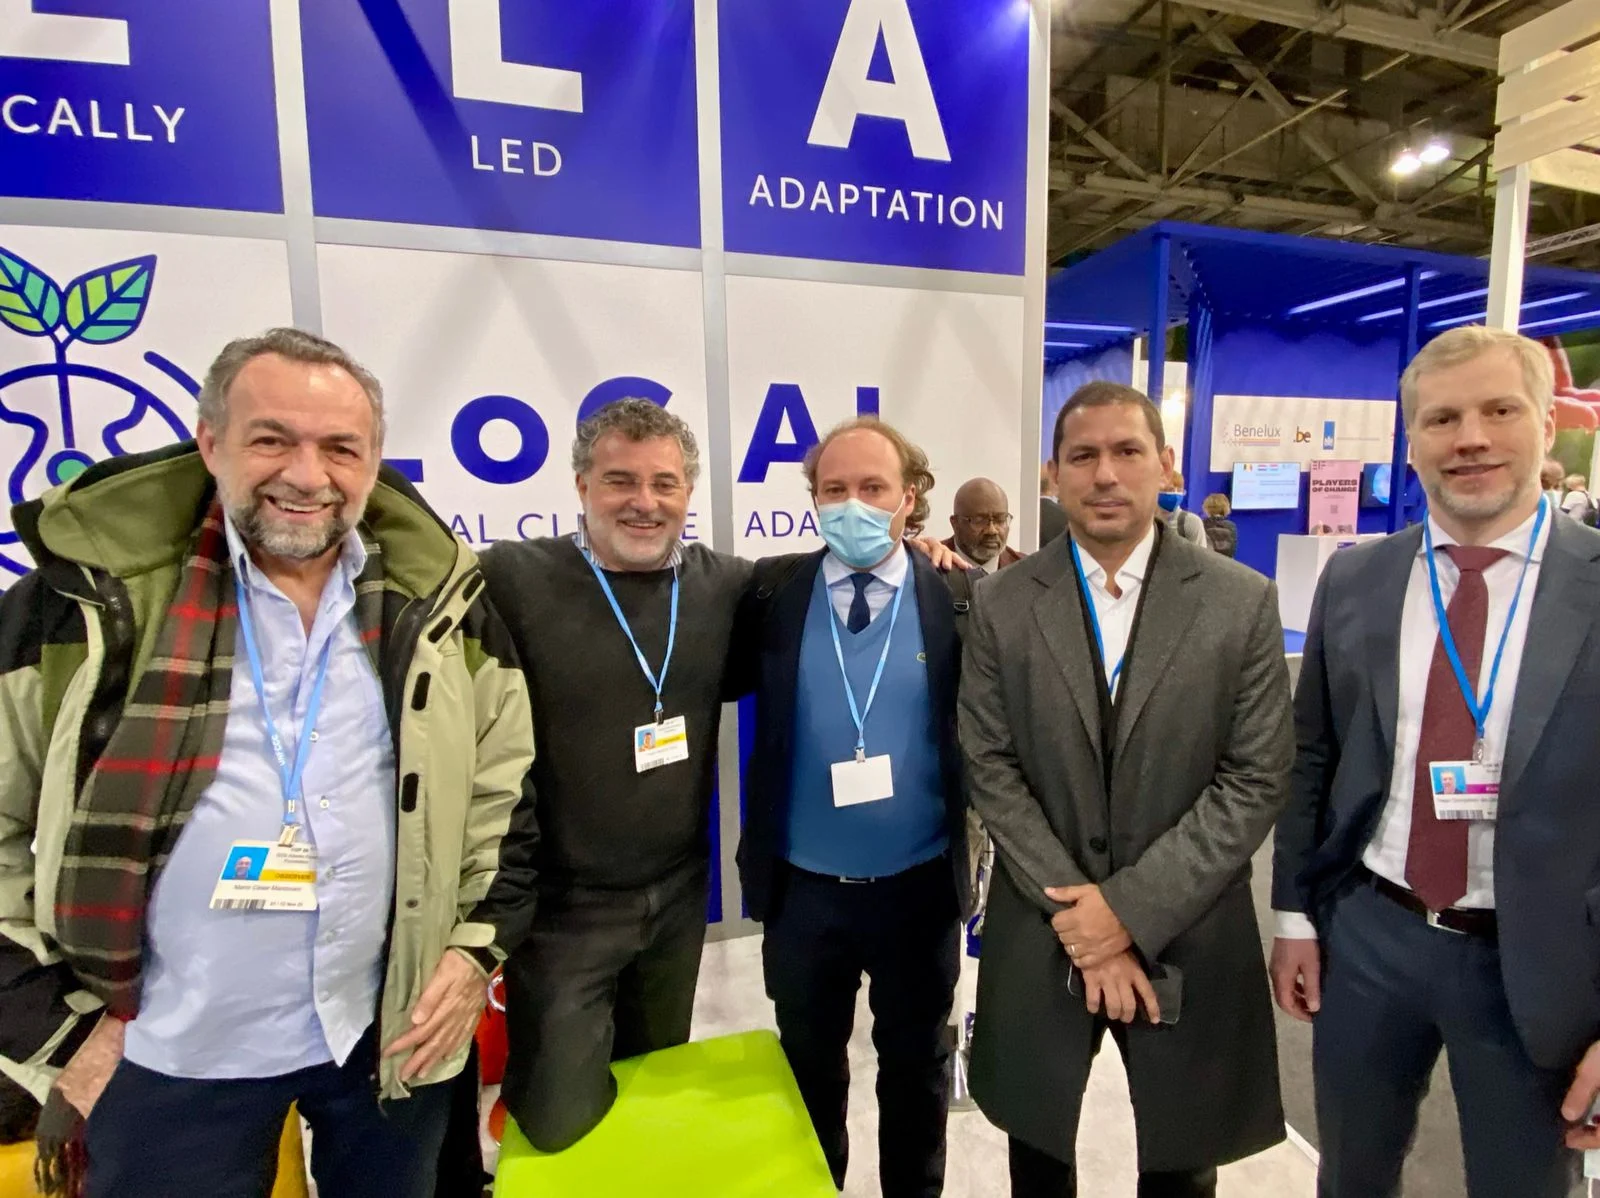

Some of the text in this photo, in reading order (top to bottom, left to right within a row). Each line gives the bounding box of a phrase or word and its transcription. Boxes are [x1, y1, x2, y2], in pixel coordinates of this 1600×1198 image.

[806, 0, 951, 162] A
[2, 94, 186, 143] CALLY
[471, 135, 562, 177] LED
[749, 174, 1003, 230] ADAPTATION
[1234, 423, 1281, 438] Benelux
